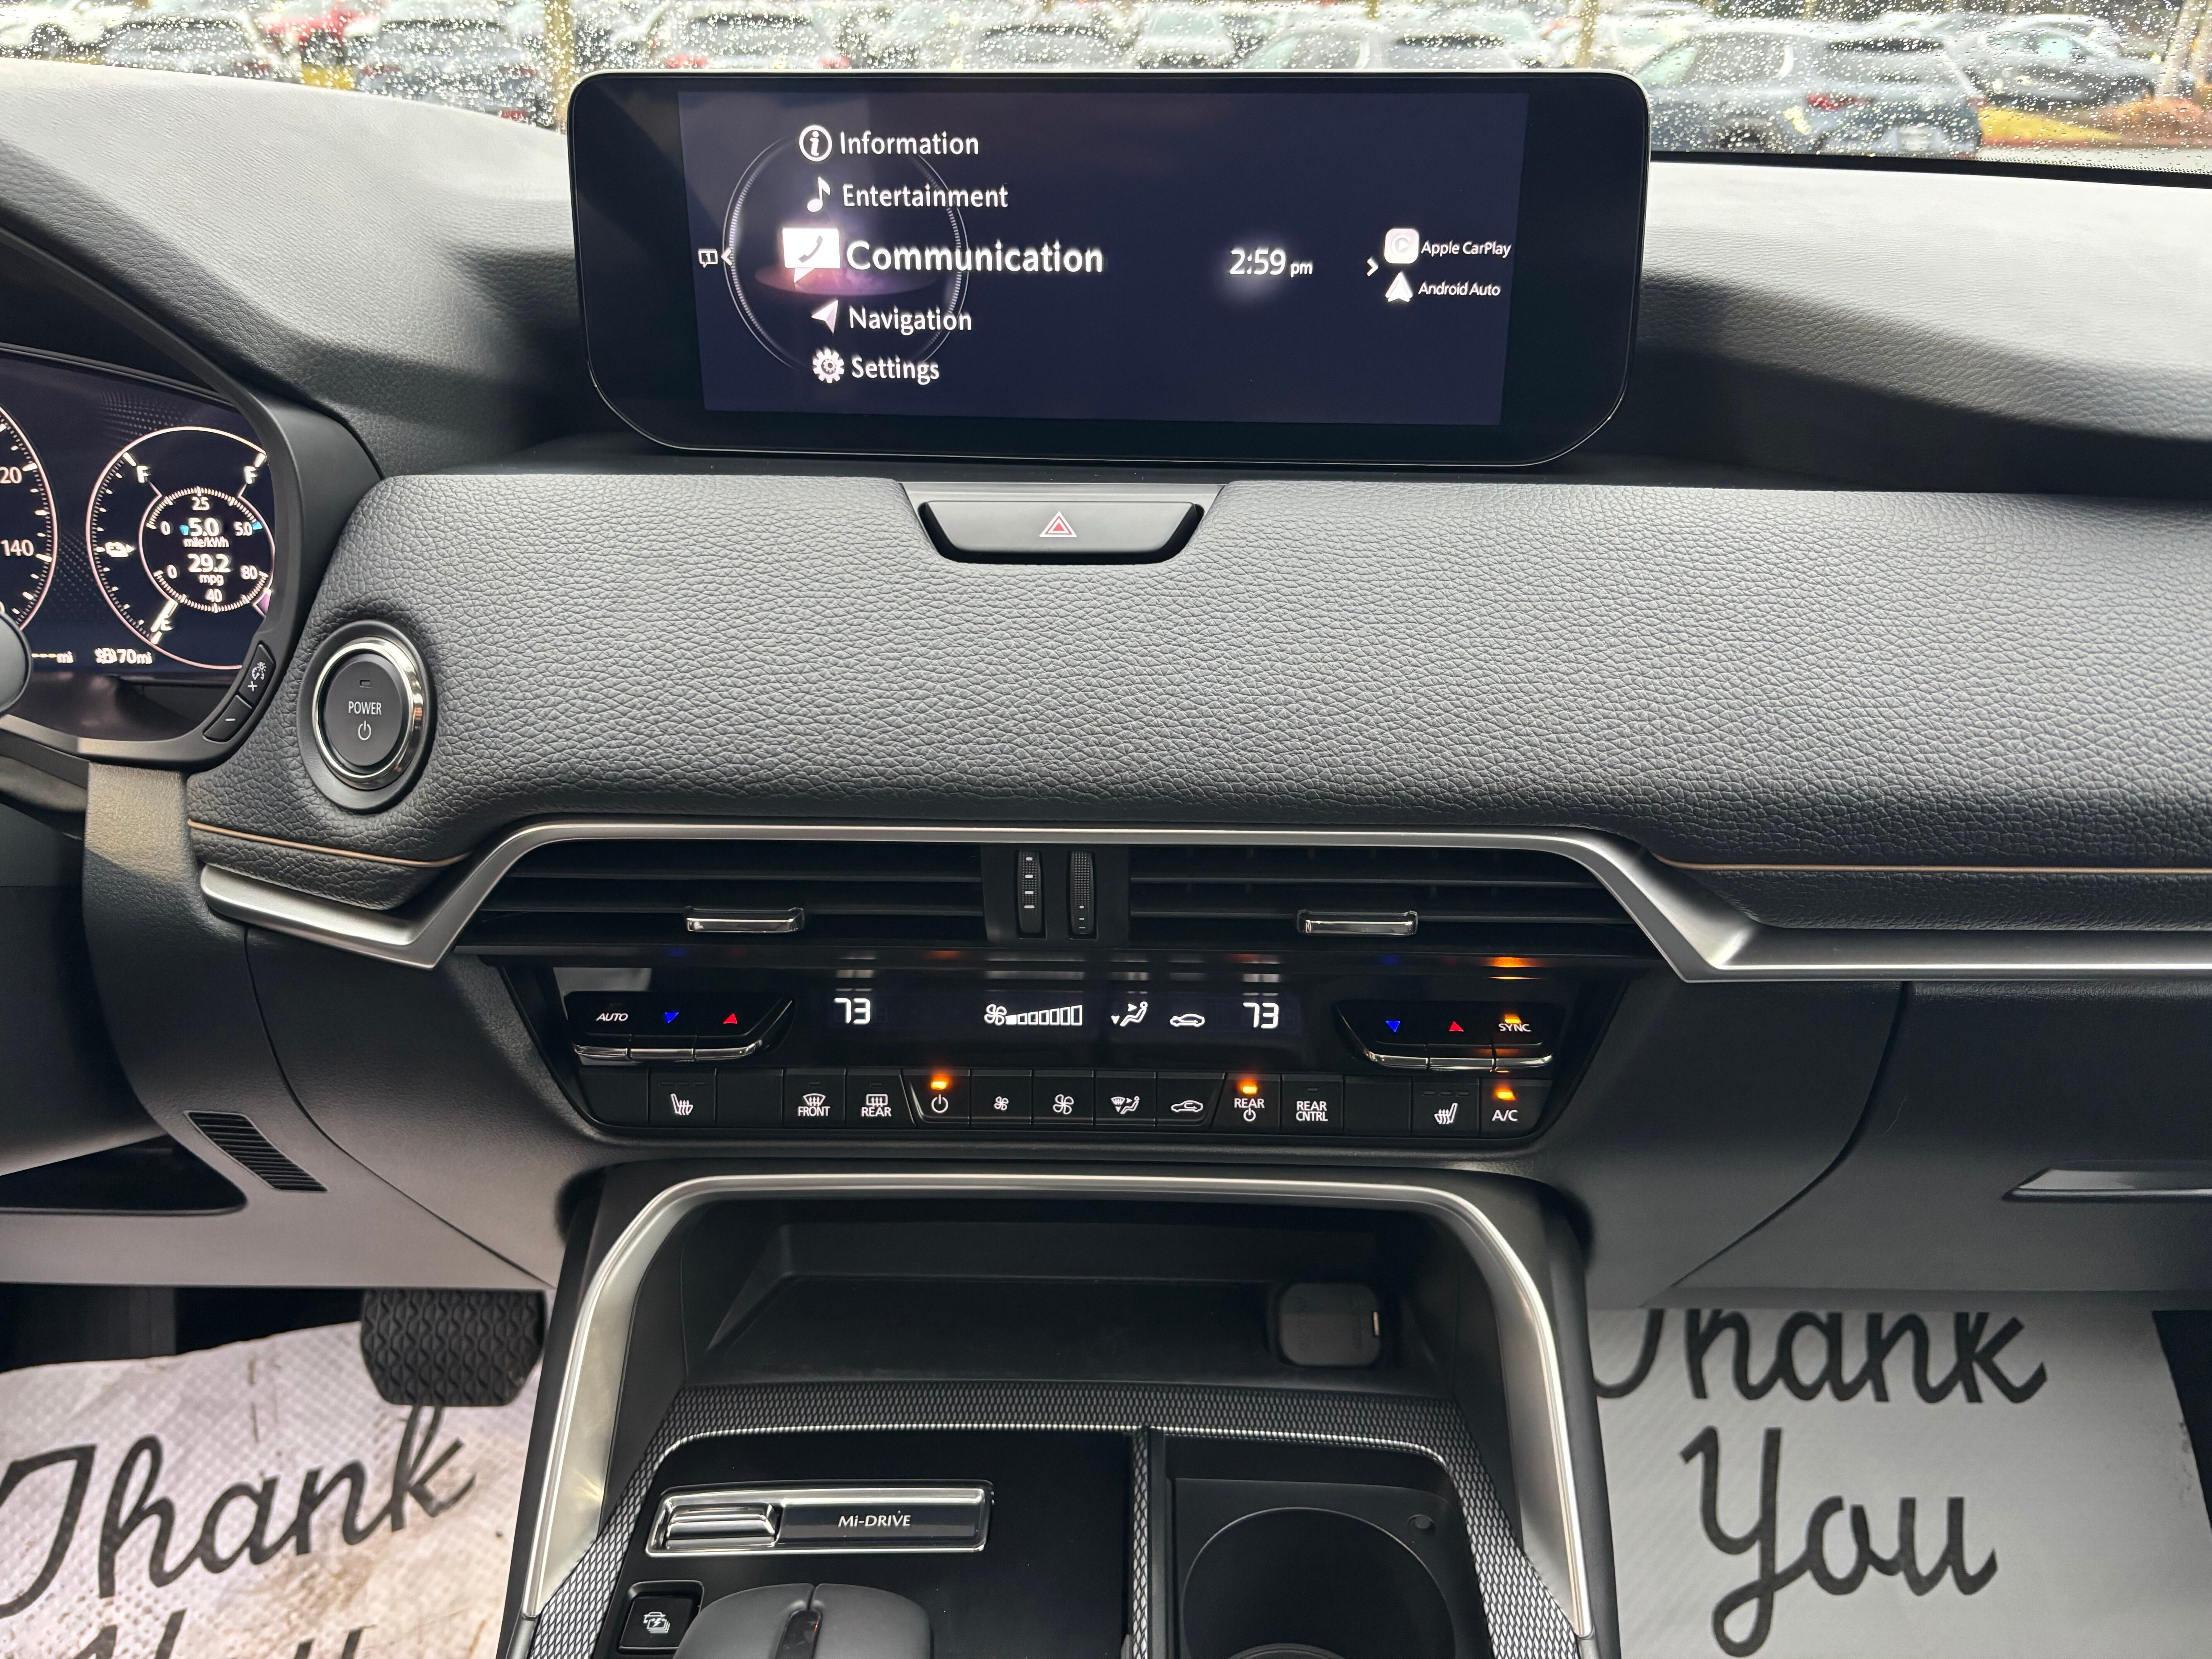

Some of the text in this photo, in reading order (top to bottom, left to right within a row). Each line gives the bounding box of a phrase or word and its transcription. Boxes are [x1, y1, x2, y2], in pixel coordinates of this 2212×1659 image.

[840, 131, 979, 156] Information
[842, 184, 1008, 208] Entertainment
[847, 239, 1104, 273] Communication
[1421, 240, 1512, 258] Apple CarPlay
[1230, 248, 1313, 278] 2:59 pm
[1418, 281, 1501, 296] Android Auto
[849, 307, 972, 336] Navigation
[852, 356, 939, 385] Settings
[136, 465, 149, 483] F
[244, 466, 256, 484] F
[160, 521, 170, 535] 0
[188, 517, 220, 537] 5.0
[1, 539, 34, 556] 140
[187, 553, 232, 573] 29.2
[167, 565, 177, 579] 0
[198, 574, 224, 586] mpg
[240, 565, 258, 580] 80
[205, 589, 223, 603] 40
[349, 701, 381, 715] POWER
[596, 1013, 628, 1022] AUTO
[834, 998, 871, 1025] 73
[1243, 1002, 1279, 1029] 73
[1499, 1023, 1531, 1032] SYNC
[798, 1106, 831, 1116] FRONT
[1234, 1098, 1265, 1108] REAR
[1297, 1101, 1327, 1111] REAR
[861, 1107, 892, 1117] REAR
[1296, 1111, 1328, 1121] CNTRL
[1492, 1109, 1518, 1121] A/C
[0, 1434, 476, 1619] Thank
[838, 1515, 911, 1527] Mi-DRIVE
[1679, 1426, 1997, 1657] You
